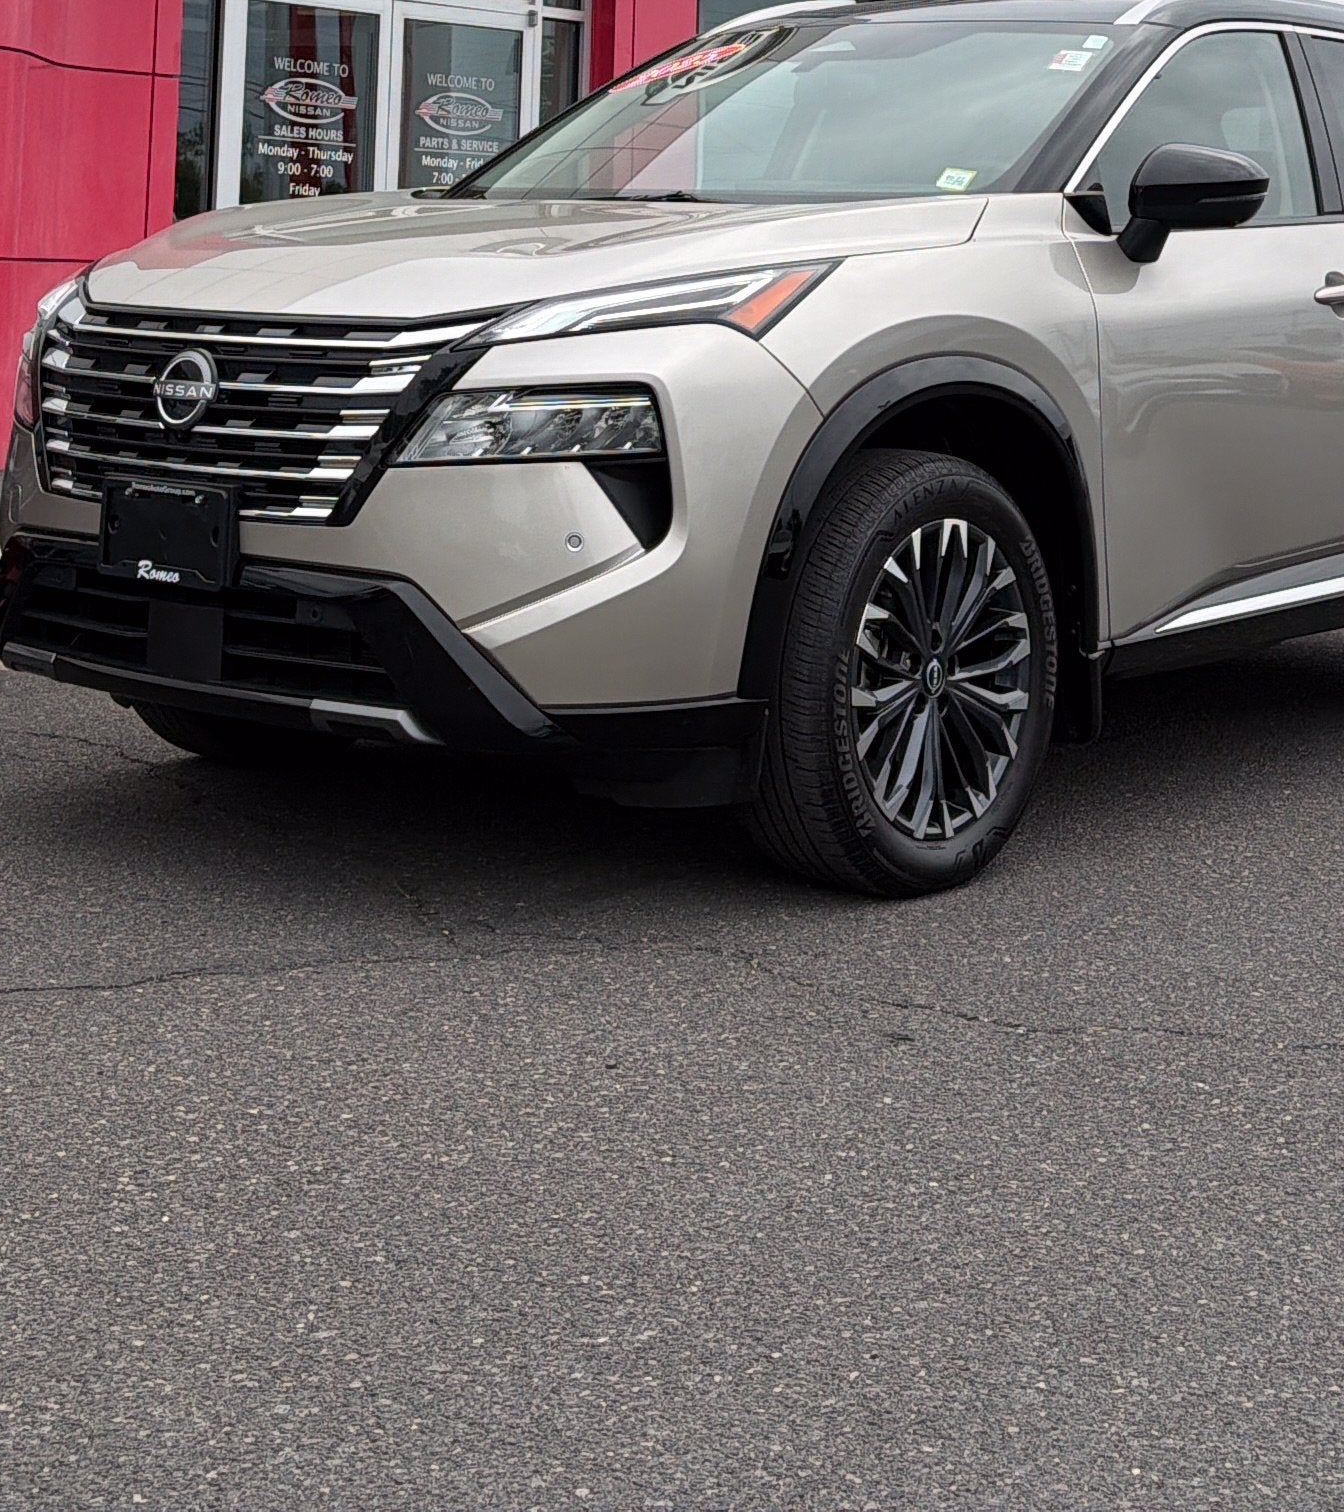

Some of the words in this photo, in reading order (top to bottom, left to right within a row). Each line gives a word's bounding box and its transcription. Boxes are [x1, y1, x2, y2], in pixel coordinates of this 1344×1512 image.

[273, 56, 330, 75] WELCOME
[332, 63, 349, 78] TO
[427, 73, 478, 89] WELCOME
[480, 77, 495, 91] TO
[278, 80, 342, 106] Romeo
[287, 104, 331, 117] NISSAN
[435, 94, 489, 118] Romeo
[439, 117, 480, 129] NISSAN
[274, 124, 306, 138] SALES
[308, 128, 344, 142] HOURS
[258, 142, 299, 160] Monday
[307, 147, 354, 164] Thursday
[419, 136, 449, 149] PARTS
[451, 138, 458, 150] &
[460, 139, 499, 153] SERVICE
[277, 162, 301, 176] 9:00
[310, 164, 334, 178] 7:00
[421, 154, 458, 170] Monday
[465, 158, 484, 169] Frid
[432, 171, 454, 185] 7:00
[289, 182, 321, 197] Friday
[153, 383, 213, 398] NISSAN
[136, 559, 181, 584] Romeo
[1019, 538, 1058, 710] BRIDGESTONE
[833, 649, 875, 837] BRIDGESTONE
